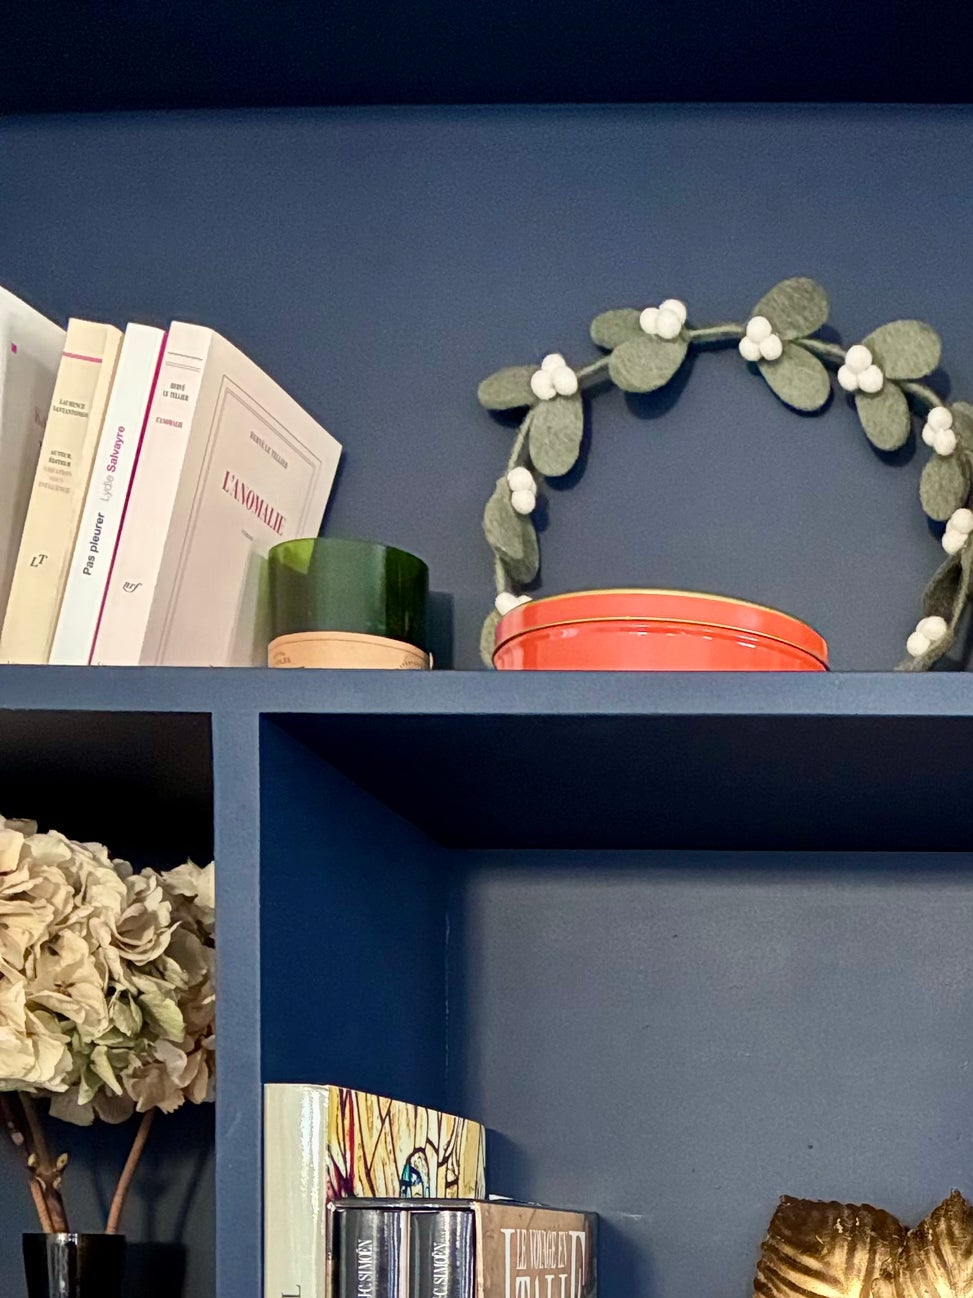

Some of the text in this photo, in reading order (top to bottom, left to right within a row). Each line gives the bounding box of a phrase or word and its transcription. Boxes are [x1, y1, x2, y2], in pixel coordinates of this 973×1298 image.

[100, 425, 125, 502] Lydie Salvayre
[222, 470, 286, 536] L'ANOMALIE
[83, 512, 105, 575] Pas pleurer
[515, 1229, 568, 1270] LE VOYAGE EN
